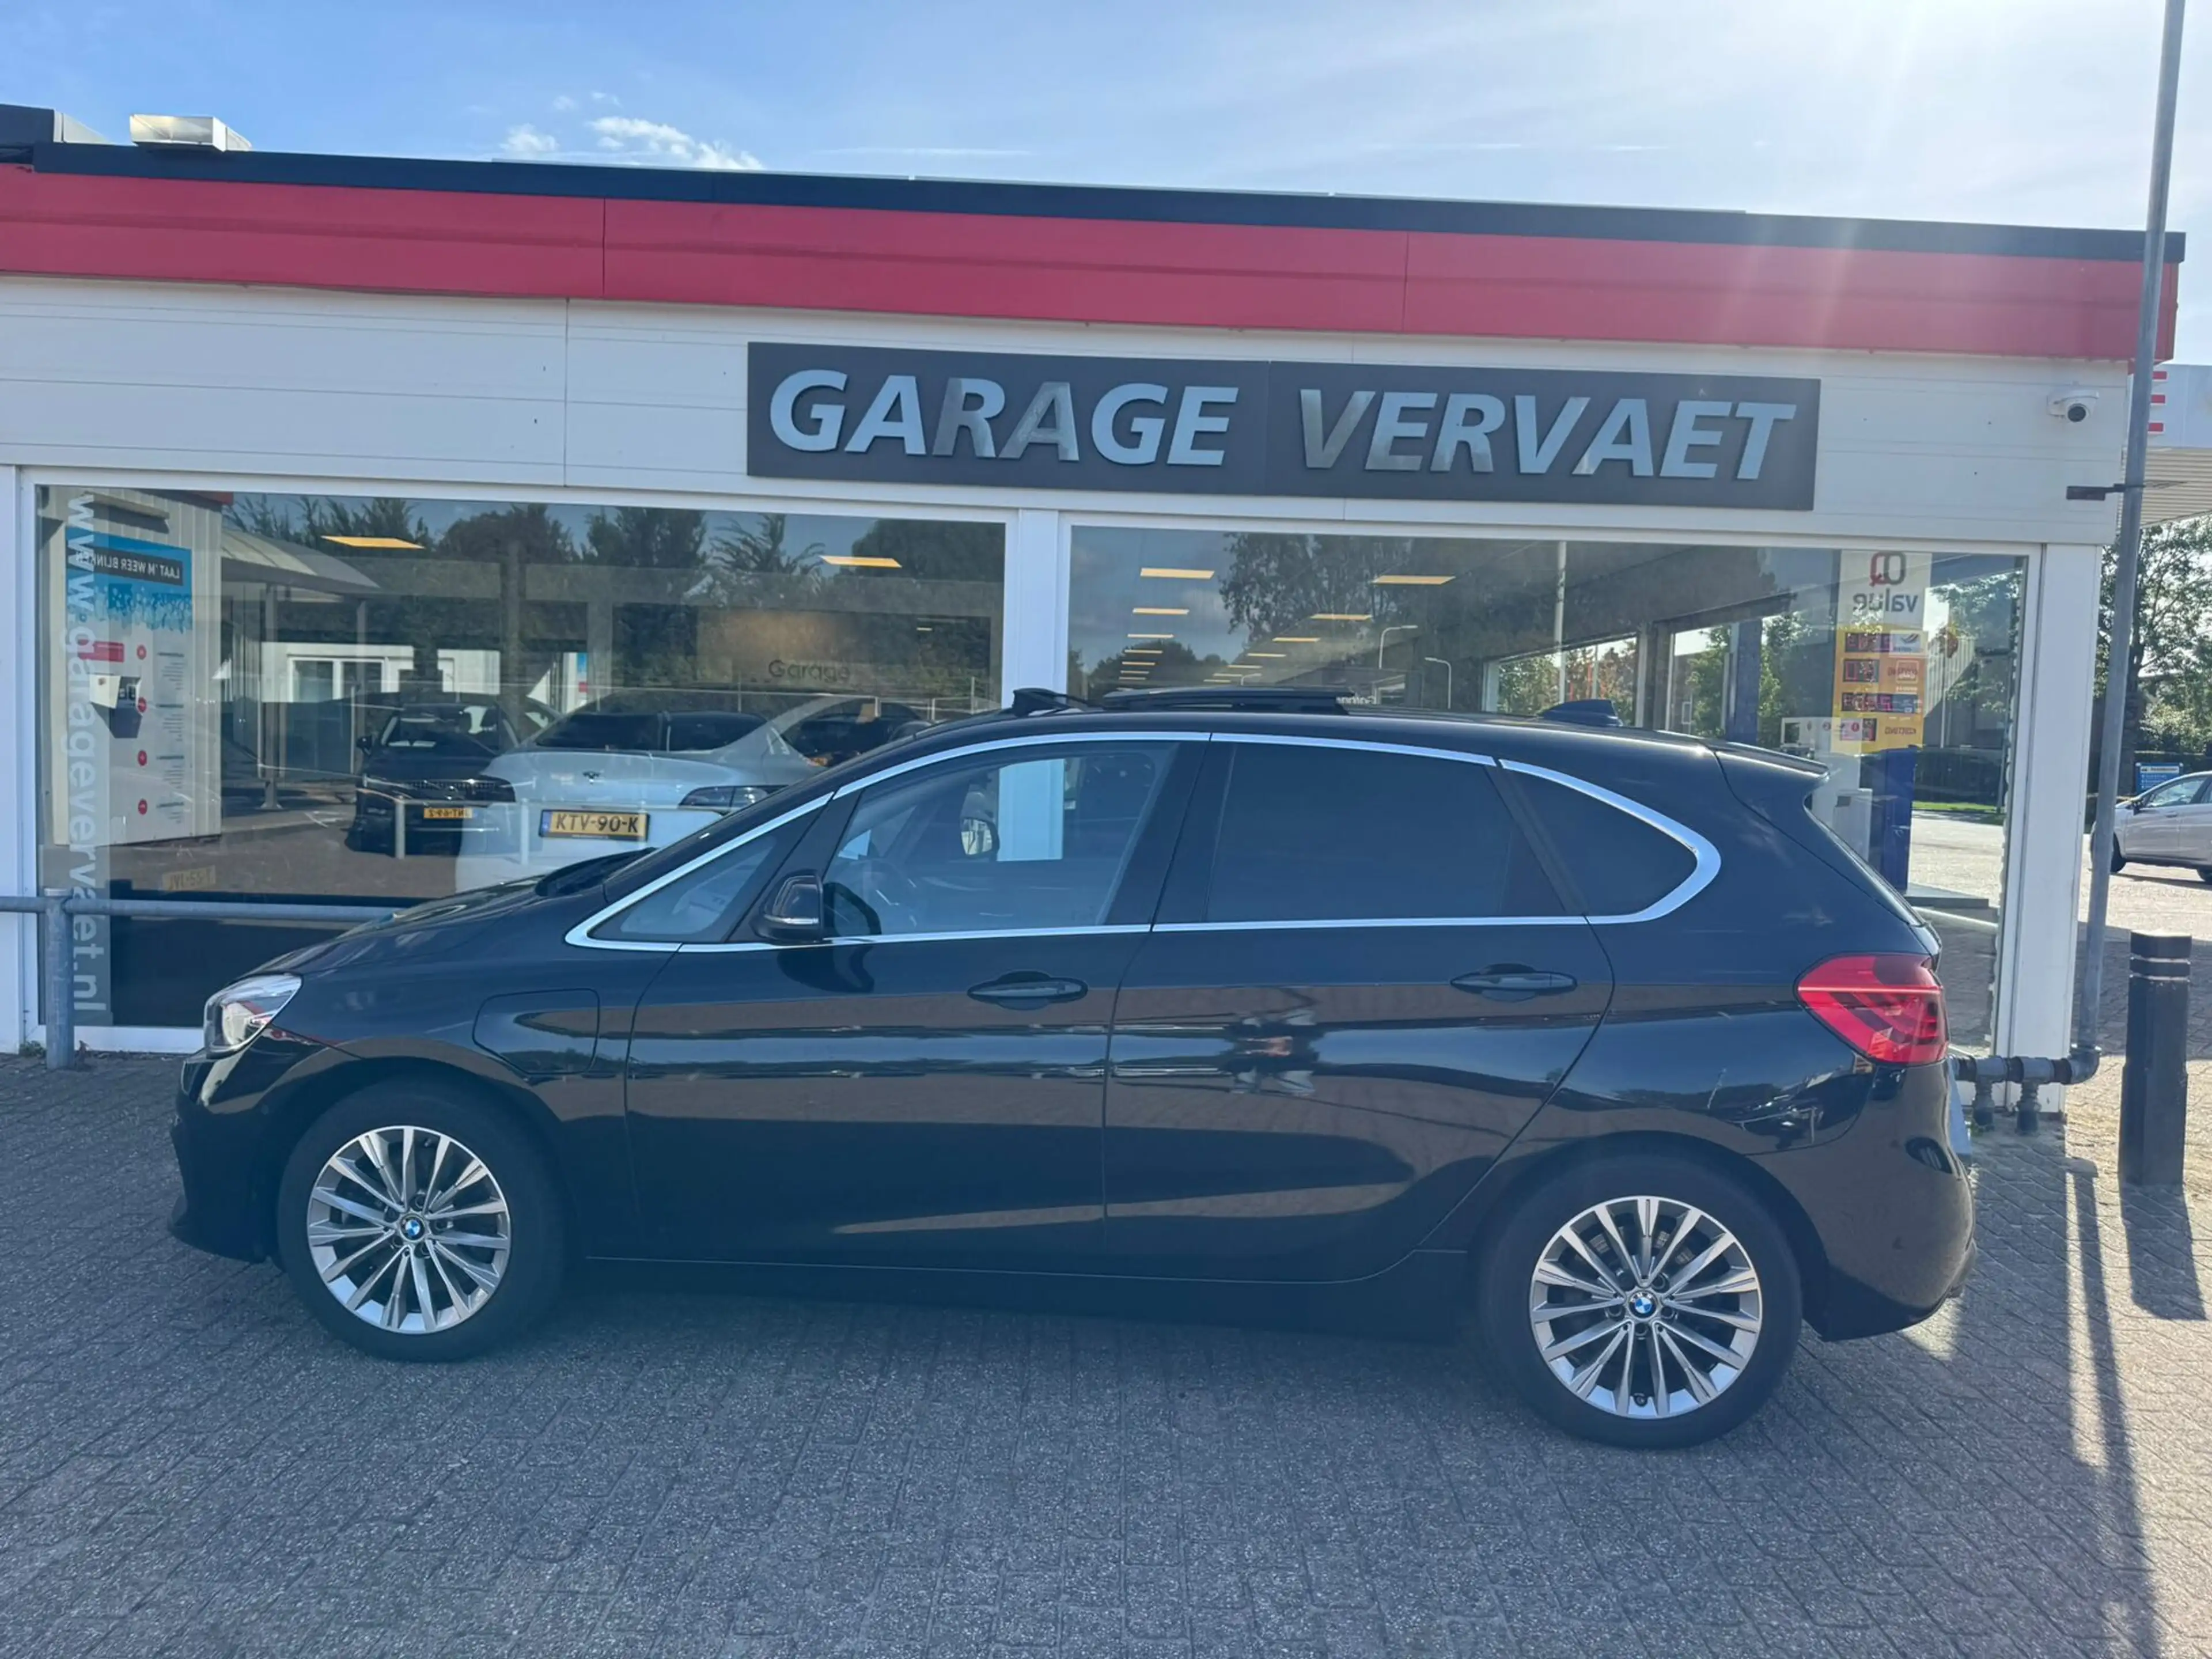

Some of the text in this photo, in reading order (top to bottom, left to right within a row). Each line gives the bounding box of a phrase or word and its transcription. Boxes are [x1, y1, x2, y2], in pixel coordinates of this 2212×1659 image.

[770, 369, 1797, 480] GARAGE VERVAET
[768, 659, 850, 683] Garage
[60, 494, 107, 1010] www.garagevervaet.nl
[556, 813, 639, 833] KTV-90-K
